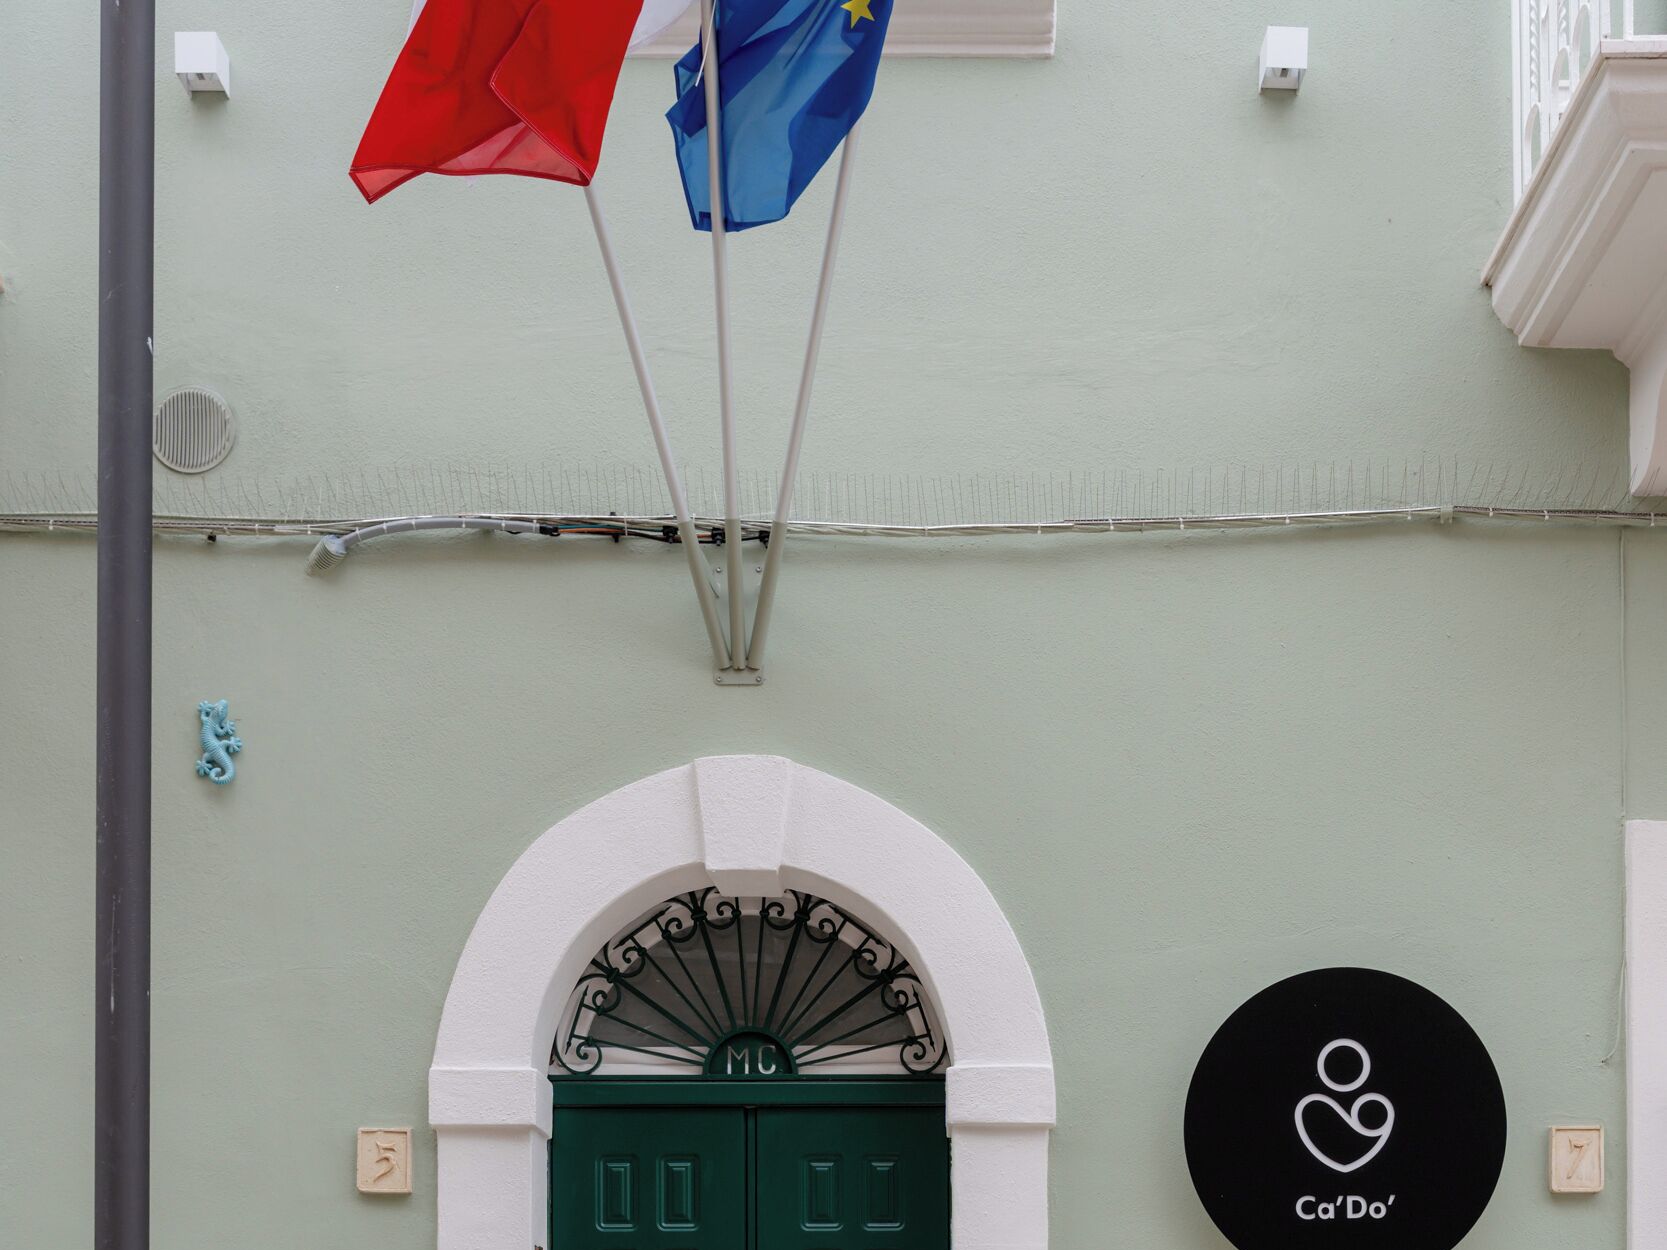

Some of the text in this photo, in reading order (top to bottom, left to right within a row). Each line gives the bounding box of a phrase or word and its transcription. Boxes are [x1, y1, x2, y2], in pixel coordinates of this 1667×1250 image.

[727, 1045, 776, 1075] MC
[373, 1140, 399, 1184] 5
[1566, 1135, 1592, 1180] 7
[1295, 1194, 1396, 1220] Ca'Do'
